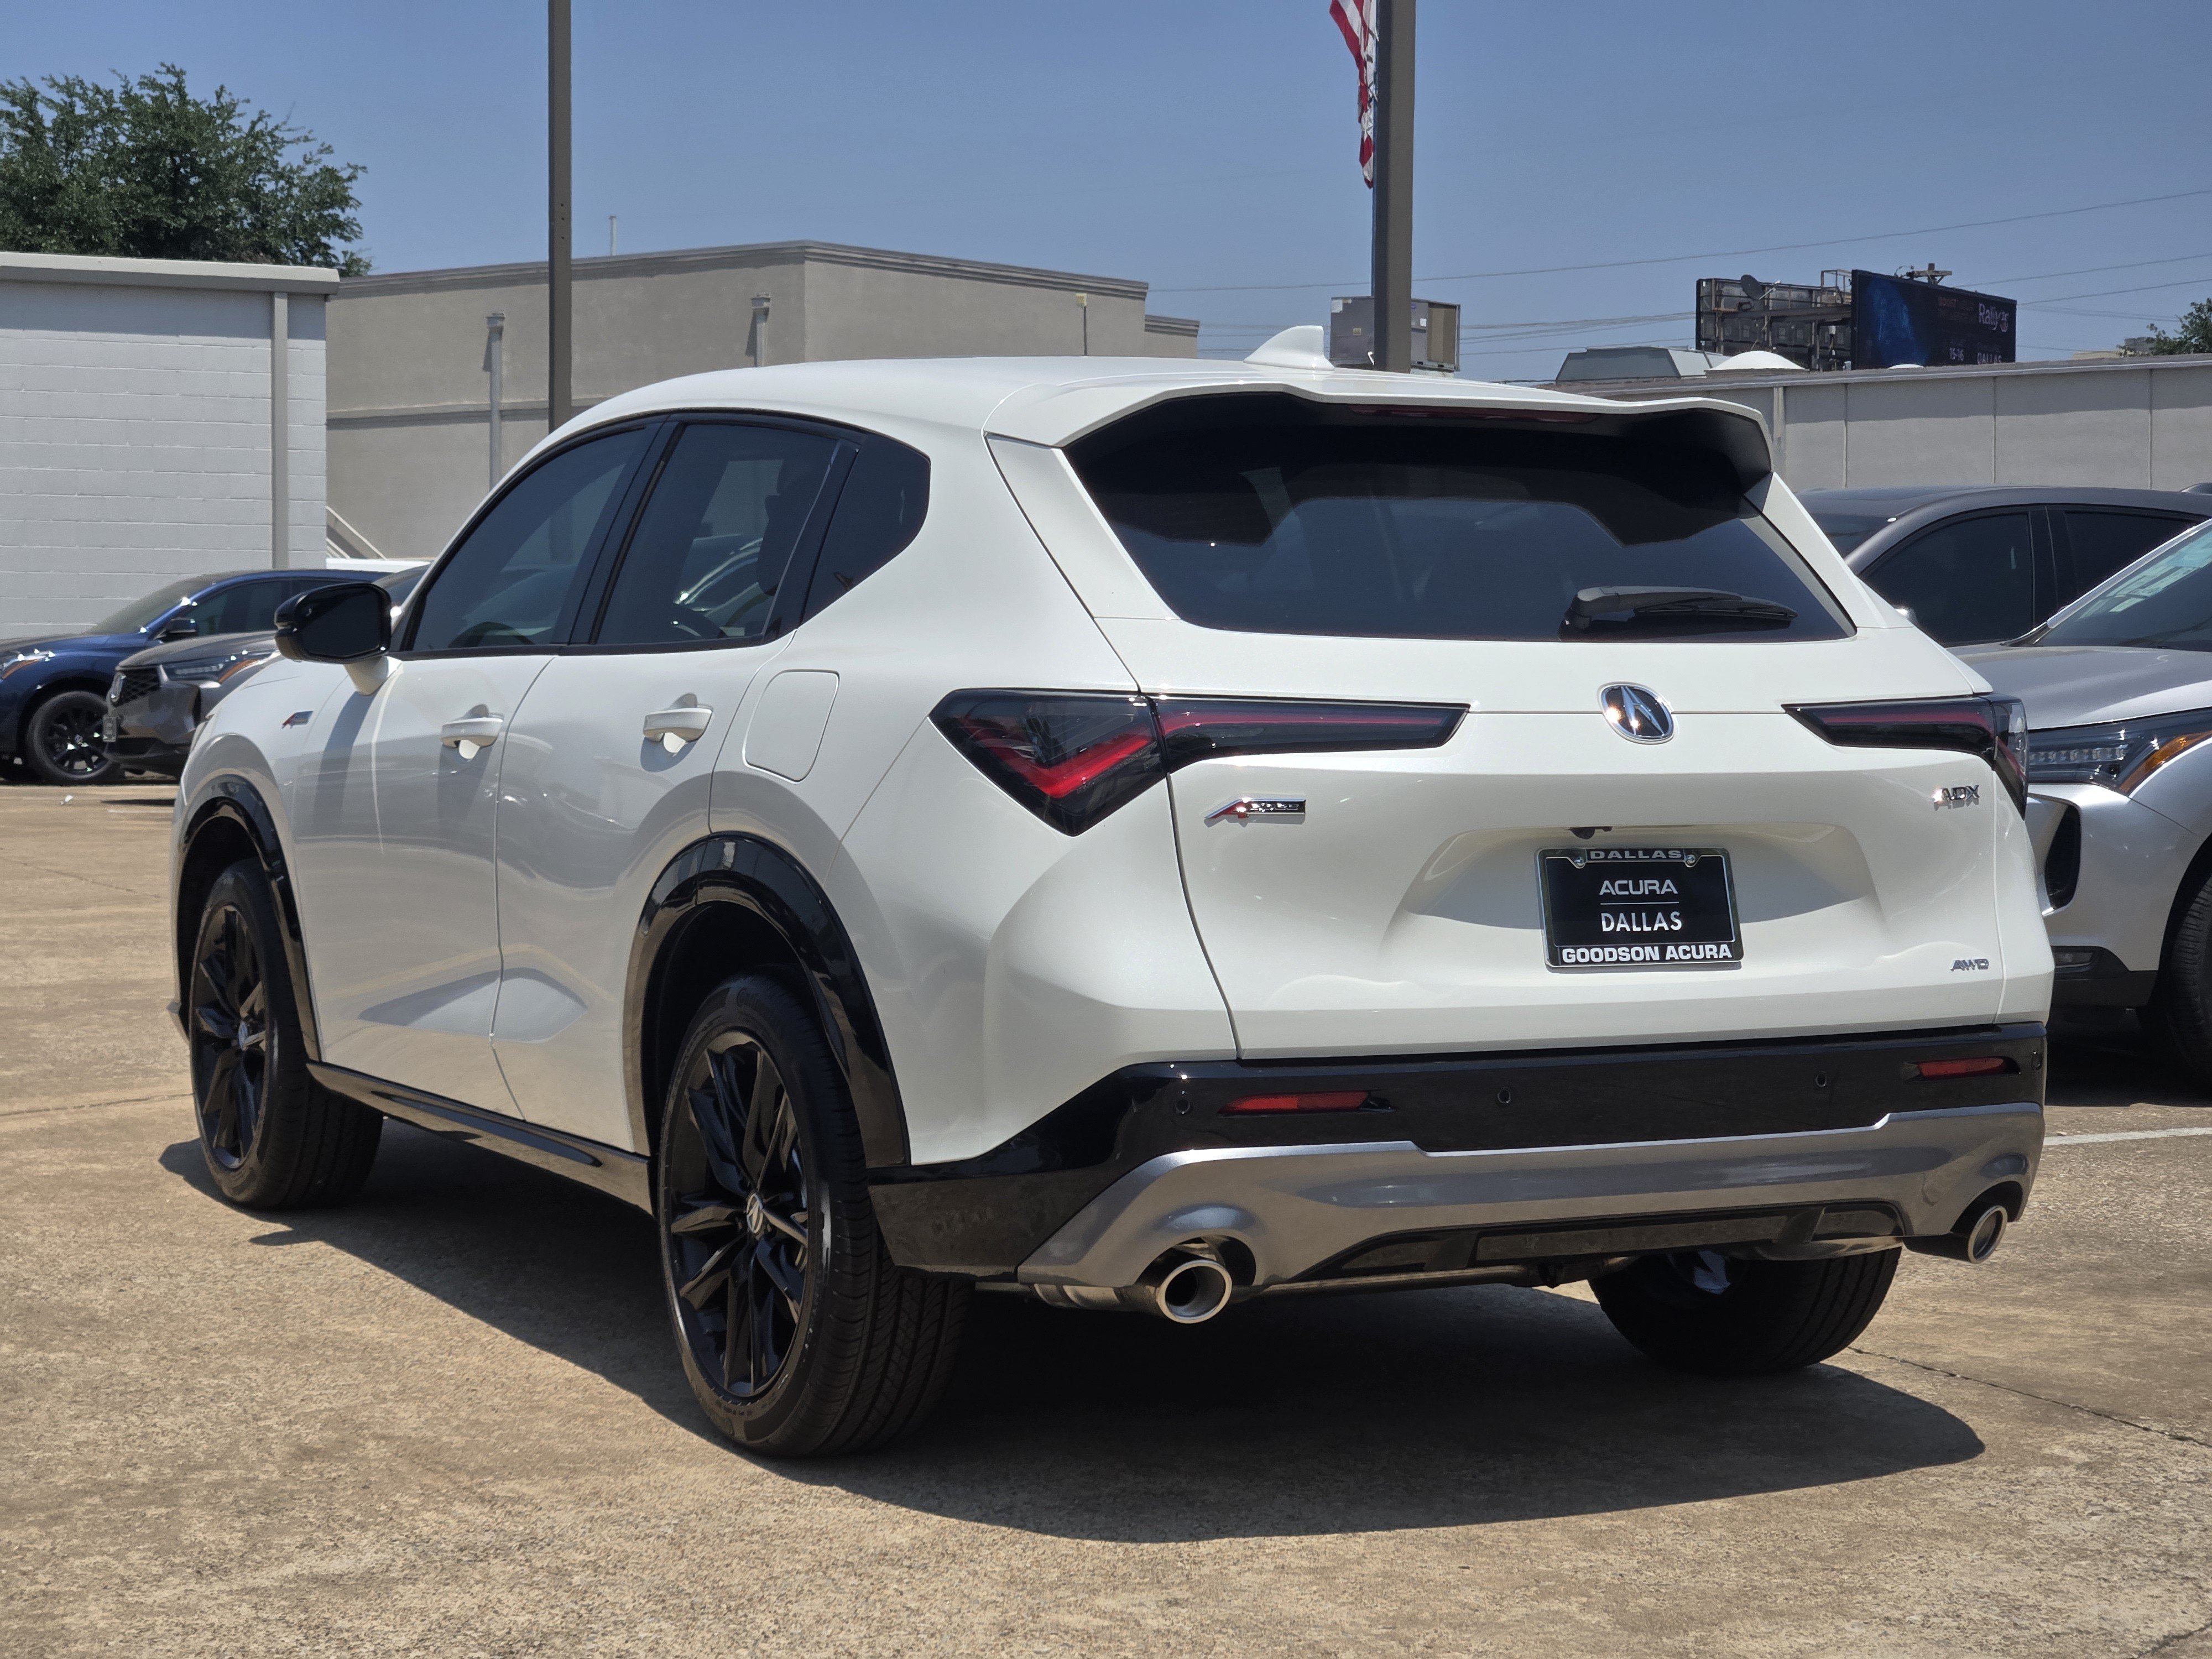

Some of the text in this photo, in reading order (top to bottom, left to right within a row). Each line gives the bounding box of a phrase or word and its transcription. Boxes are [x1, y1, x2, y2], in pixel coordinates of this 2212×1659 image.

[1933, 785, 1980, 802] ADX
[1590, 850, 1682, 859] DALLAS
[1599, 879, 1678, 895] ACURA
[1600, 911, 1682, 932] DALLAS
[1562, 944, 1733, 963] GOODSON ACURA
[1950, 958, 1989, 971] AWD
